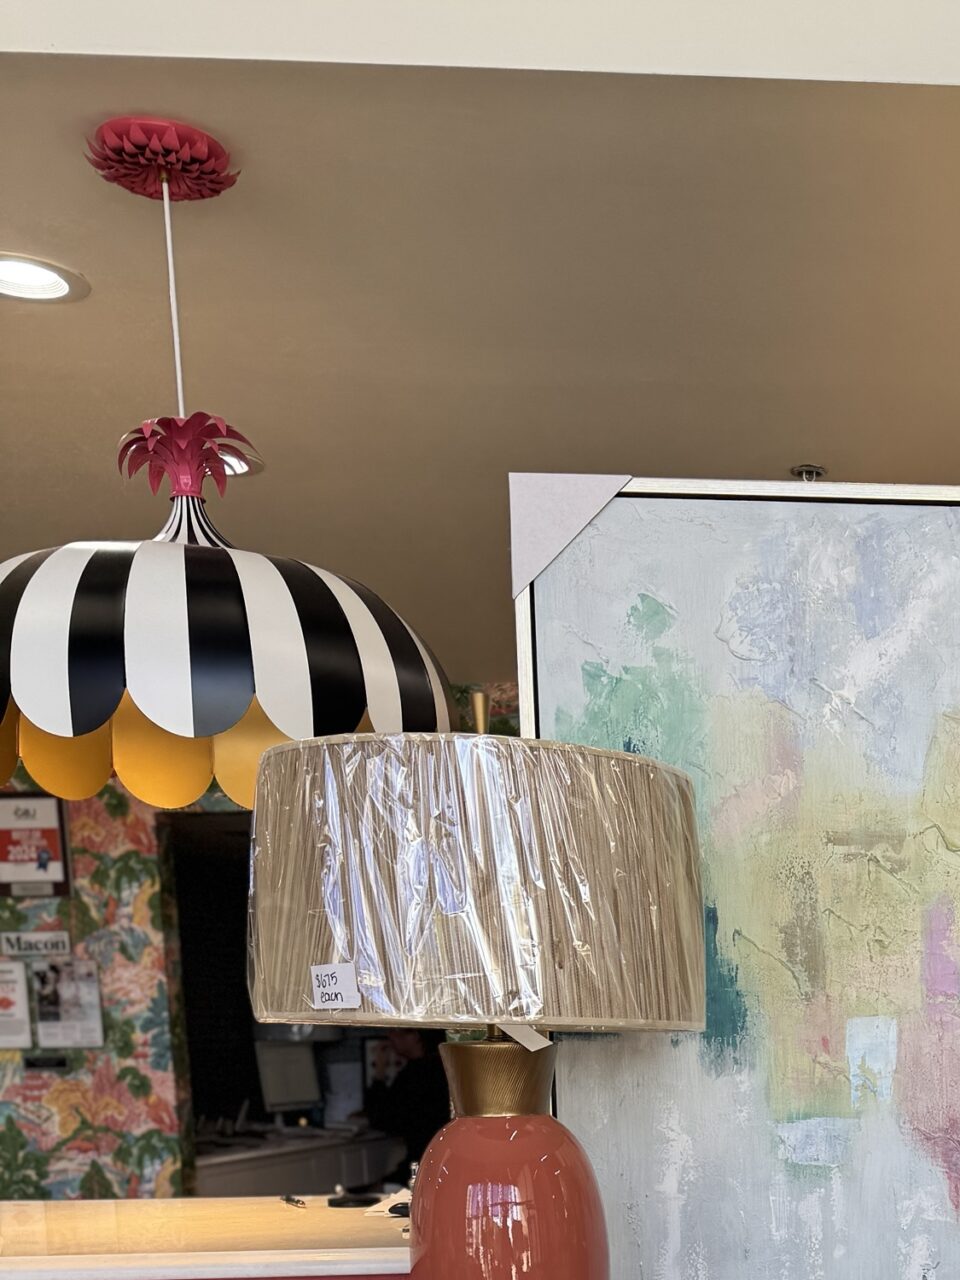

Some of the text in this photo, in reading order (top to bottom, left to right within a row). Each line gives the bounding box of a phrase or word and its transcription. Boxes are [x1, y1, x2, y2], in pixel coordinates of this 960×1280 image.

[4, 933, 67, 955] Macon
[315, 971, 338, 989] $675
[320, 991, 344, 1004] each
